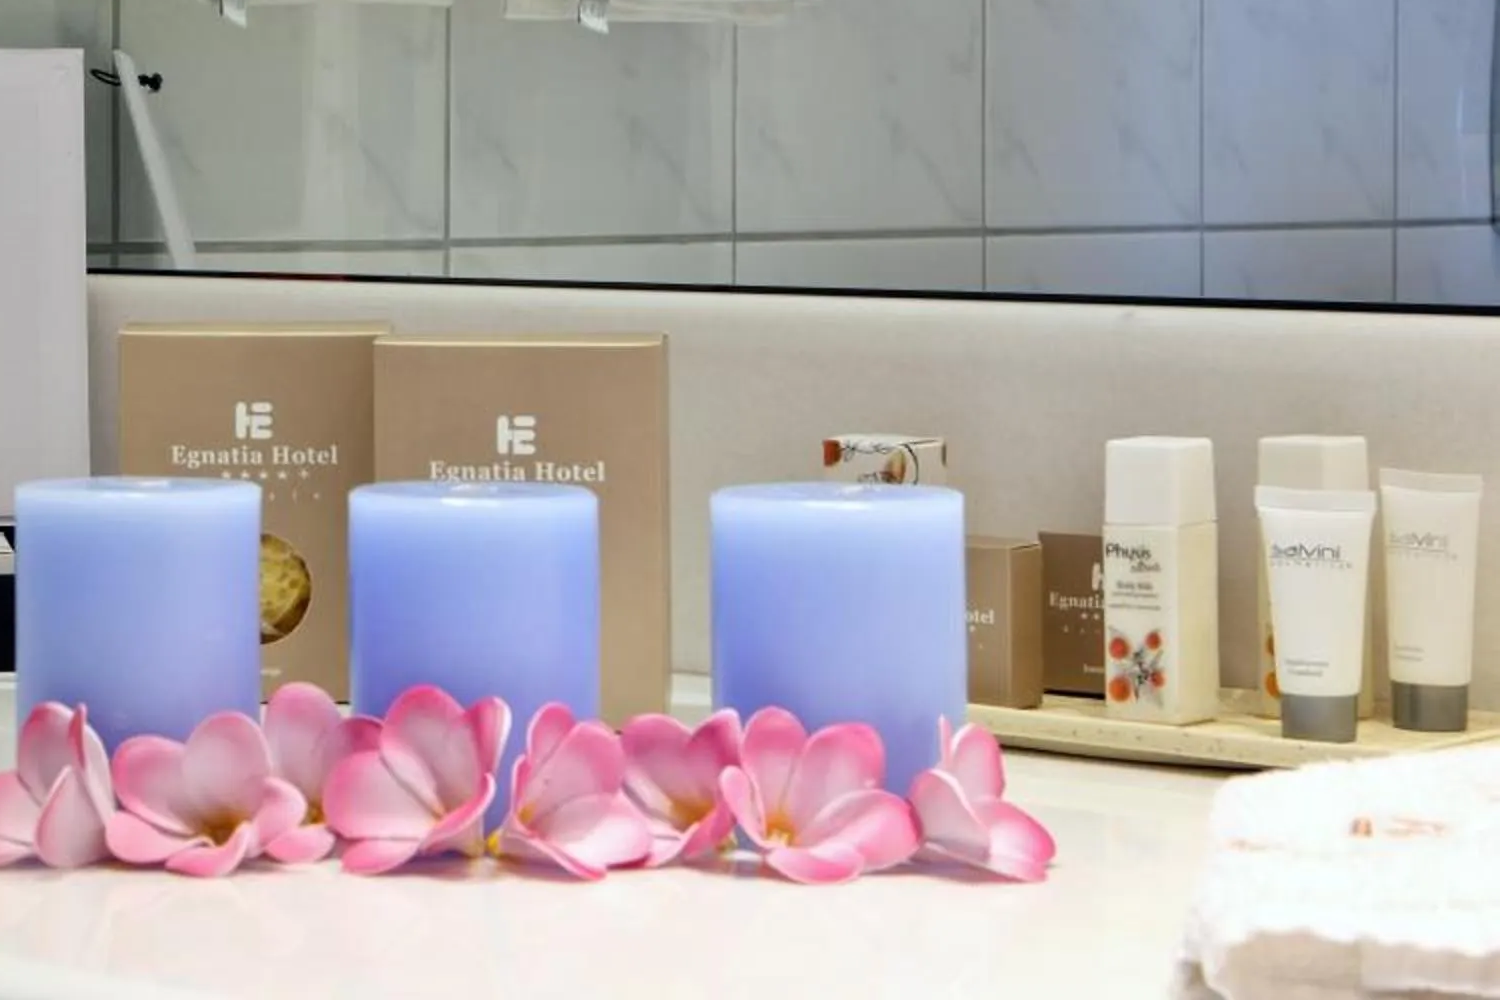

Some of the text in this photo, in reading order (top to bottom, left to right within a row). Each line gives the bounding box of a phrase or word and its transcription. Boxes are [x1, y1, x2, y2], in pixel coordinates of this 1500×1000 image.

[171, 444, 339, 469] Egnatia Hotel
[429, 459, 606, 484] Egnatia Hotel
[1050, 591, 1105, 610] Egnati
[966, 609, 995, 625] otel
